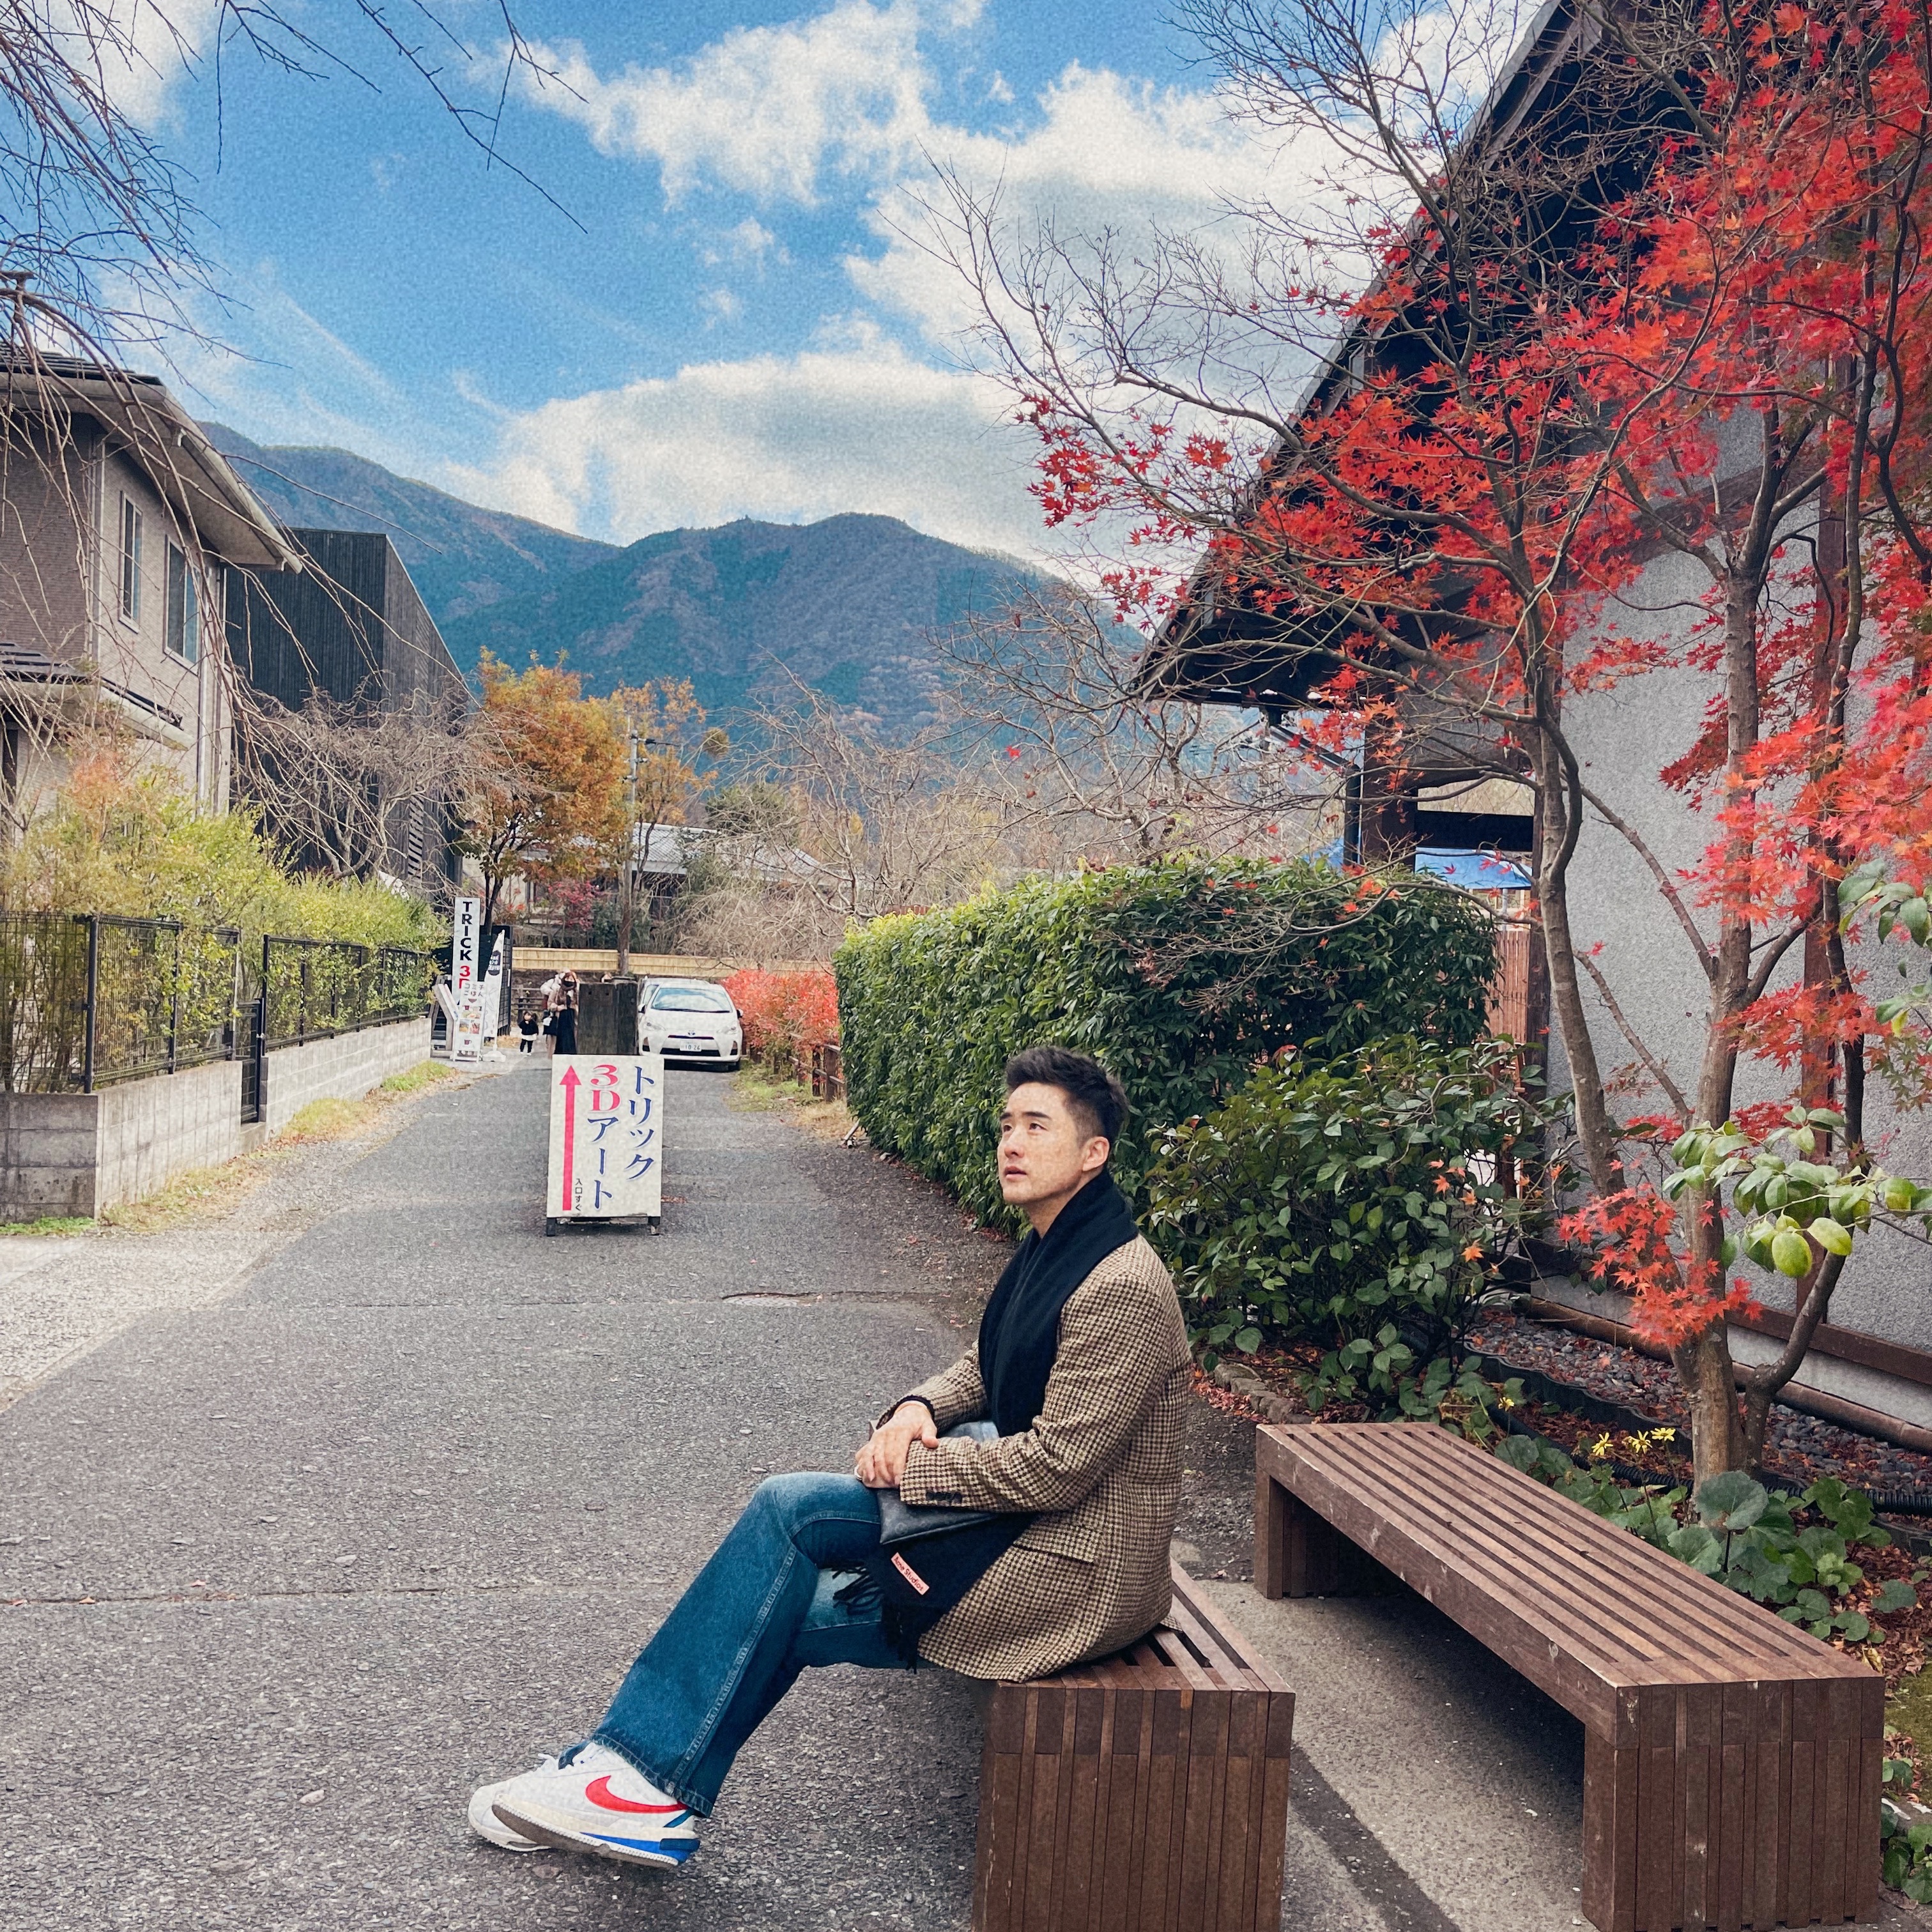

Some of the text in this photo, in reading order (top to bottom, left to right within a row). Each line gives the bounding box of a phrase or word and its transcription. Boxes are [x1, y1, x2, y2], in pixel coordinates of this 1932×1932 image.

[459, 901, 473, 962] TRICK
[624, 1066, 655, 1180] トリック
[894, 1556, 924, 1591] Acne Studios
